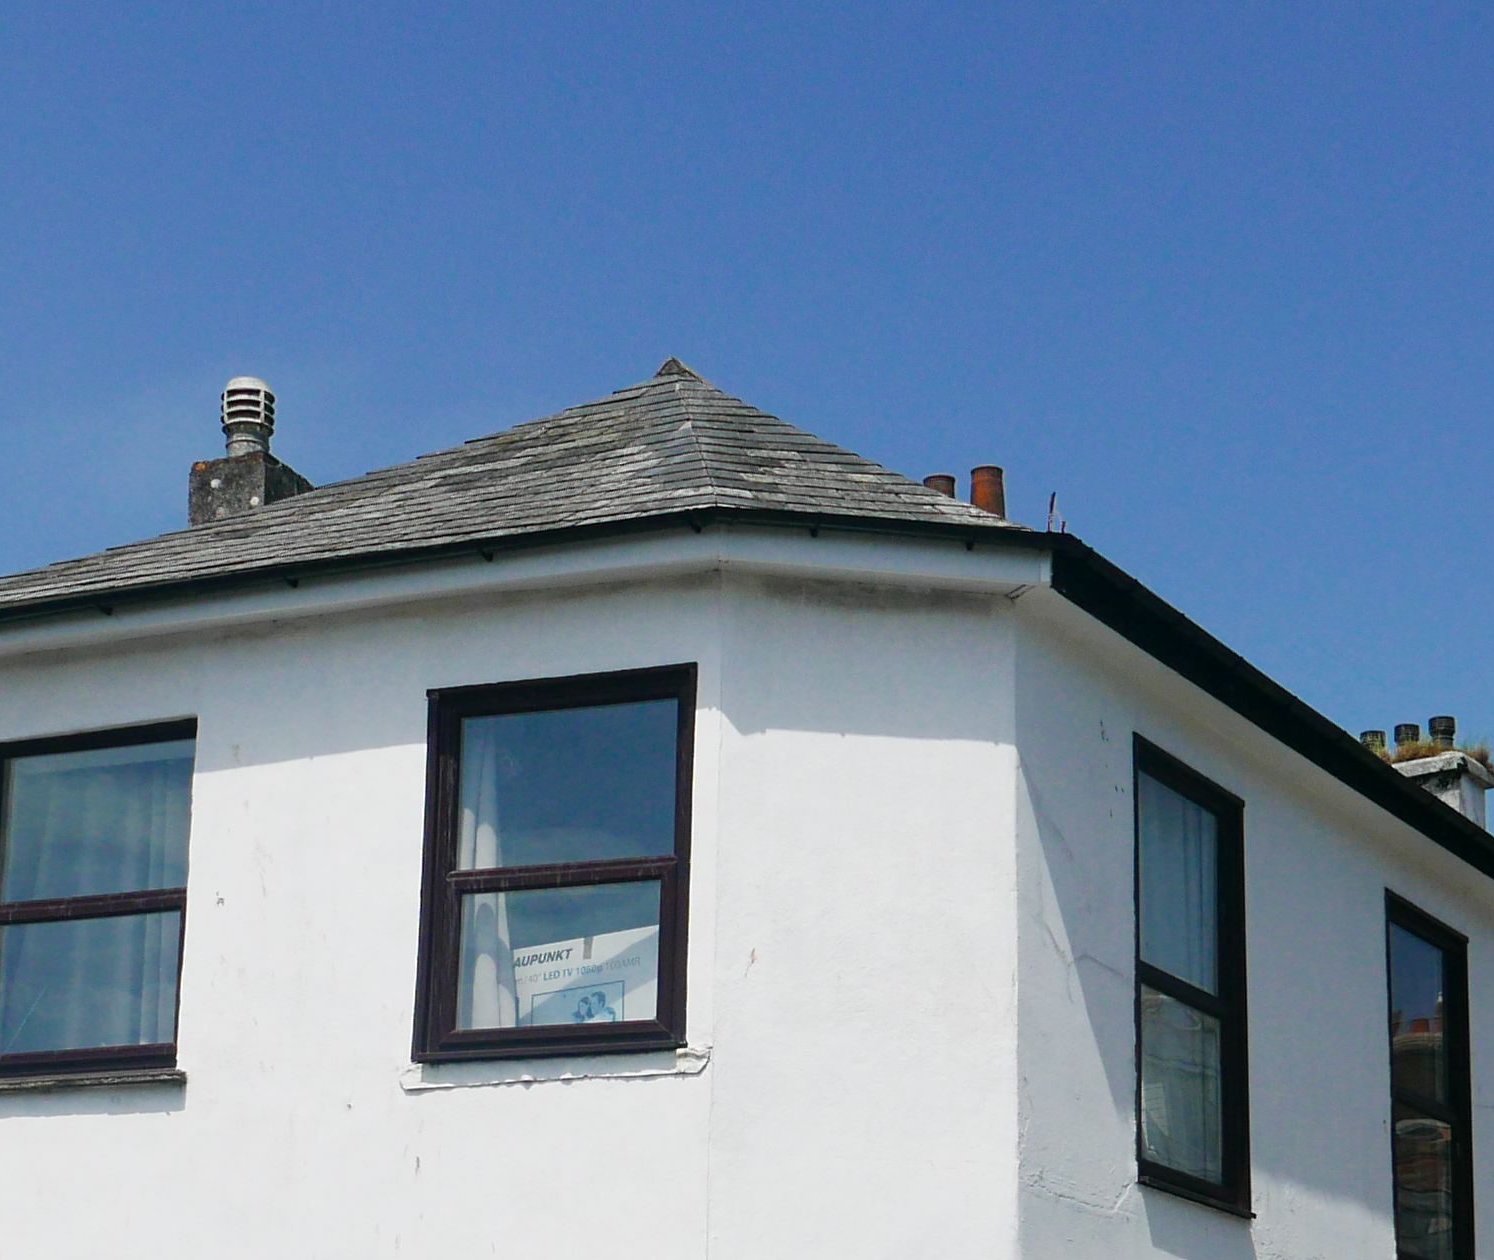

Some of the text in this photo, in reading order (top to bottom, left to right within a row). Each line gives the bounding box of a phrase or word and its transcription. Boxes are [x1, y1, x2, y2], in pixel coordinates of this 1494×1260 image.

[513, 948, 573, 968] AUPUNKT
[543, 970, 560, 981] LED
[562, 967, 574, 979] TV
